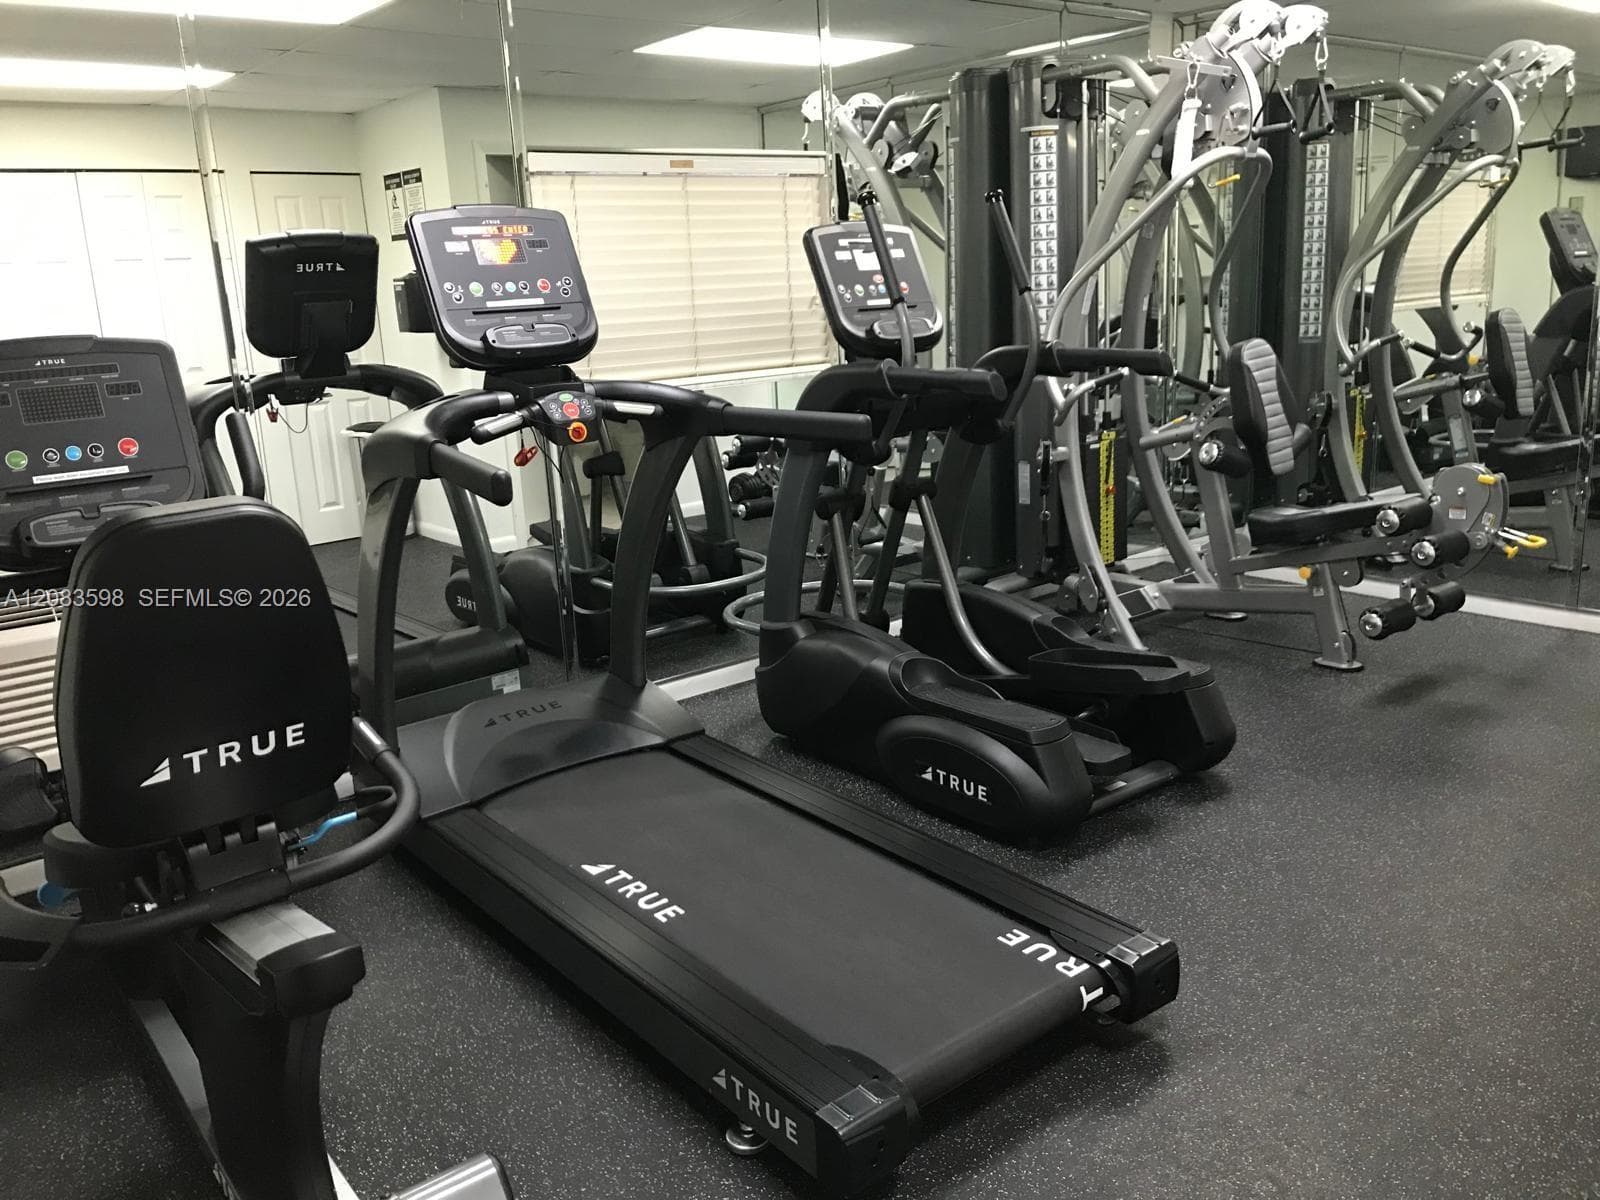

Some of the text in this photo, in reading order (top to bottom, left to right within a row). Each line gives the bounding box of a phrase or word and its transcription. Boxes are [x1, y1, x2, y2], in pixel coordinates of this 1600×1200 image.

[41, 358, 66, 366] TRUE
[499, 700, 562, 721] TRUE
[182, 722, 306, 774] TRUE
[936, 768, 988, 802] TRUE
[604, 869, 686, 923] TRUE
[996, 928, 1104, 1012] TRUE
[730, 1075, 799, 1145] TRUE
